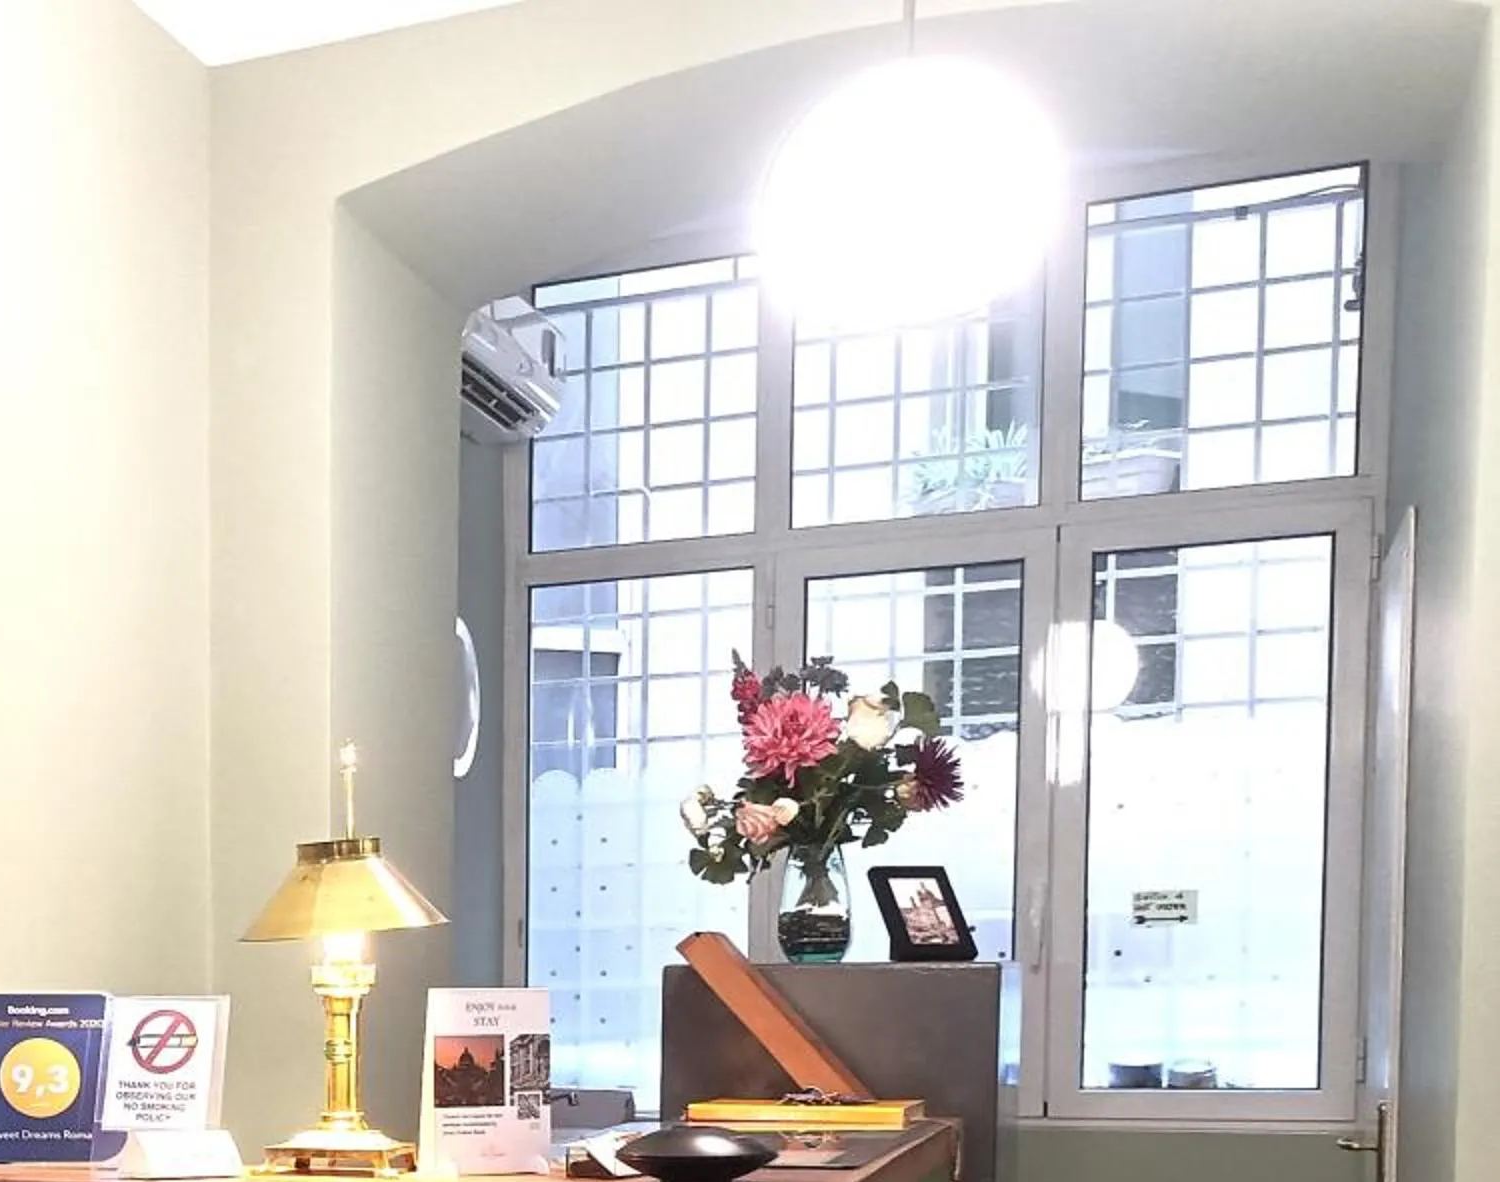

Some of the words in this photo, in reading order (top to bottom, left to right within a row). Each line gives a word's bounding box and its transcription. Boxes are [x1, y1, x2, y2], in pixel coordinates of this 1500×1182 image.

[7, 1005, 69, 1016] Booking.com
[11, 1019, 42, 1028] Review
[45, 1019, 78, 1028] Awards
[473, 1016, 500, 1026] STAY
[11, 1064, 70, 1099] 9,3
[118, 1080, 151, 1089] THANK
[154, 1080, 174, 1090] YOU
[175, 1081, 197, 1090] FOR
[115, 1091, 173, 1101] OBSERVING
[175, 1092, 197, 1101] OUR
[123, 1102, 139, 1111] NO
[140, 1102, 186, 1112] SMOKING
[21, 1129, 61, 1140] Dreams
